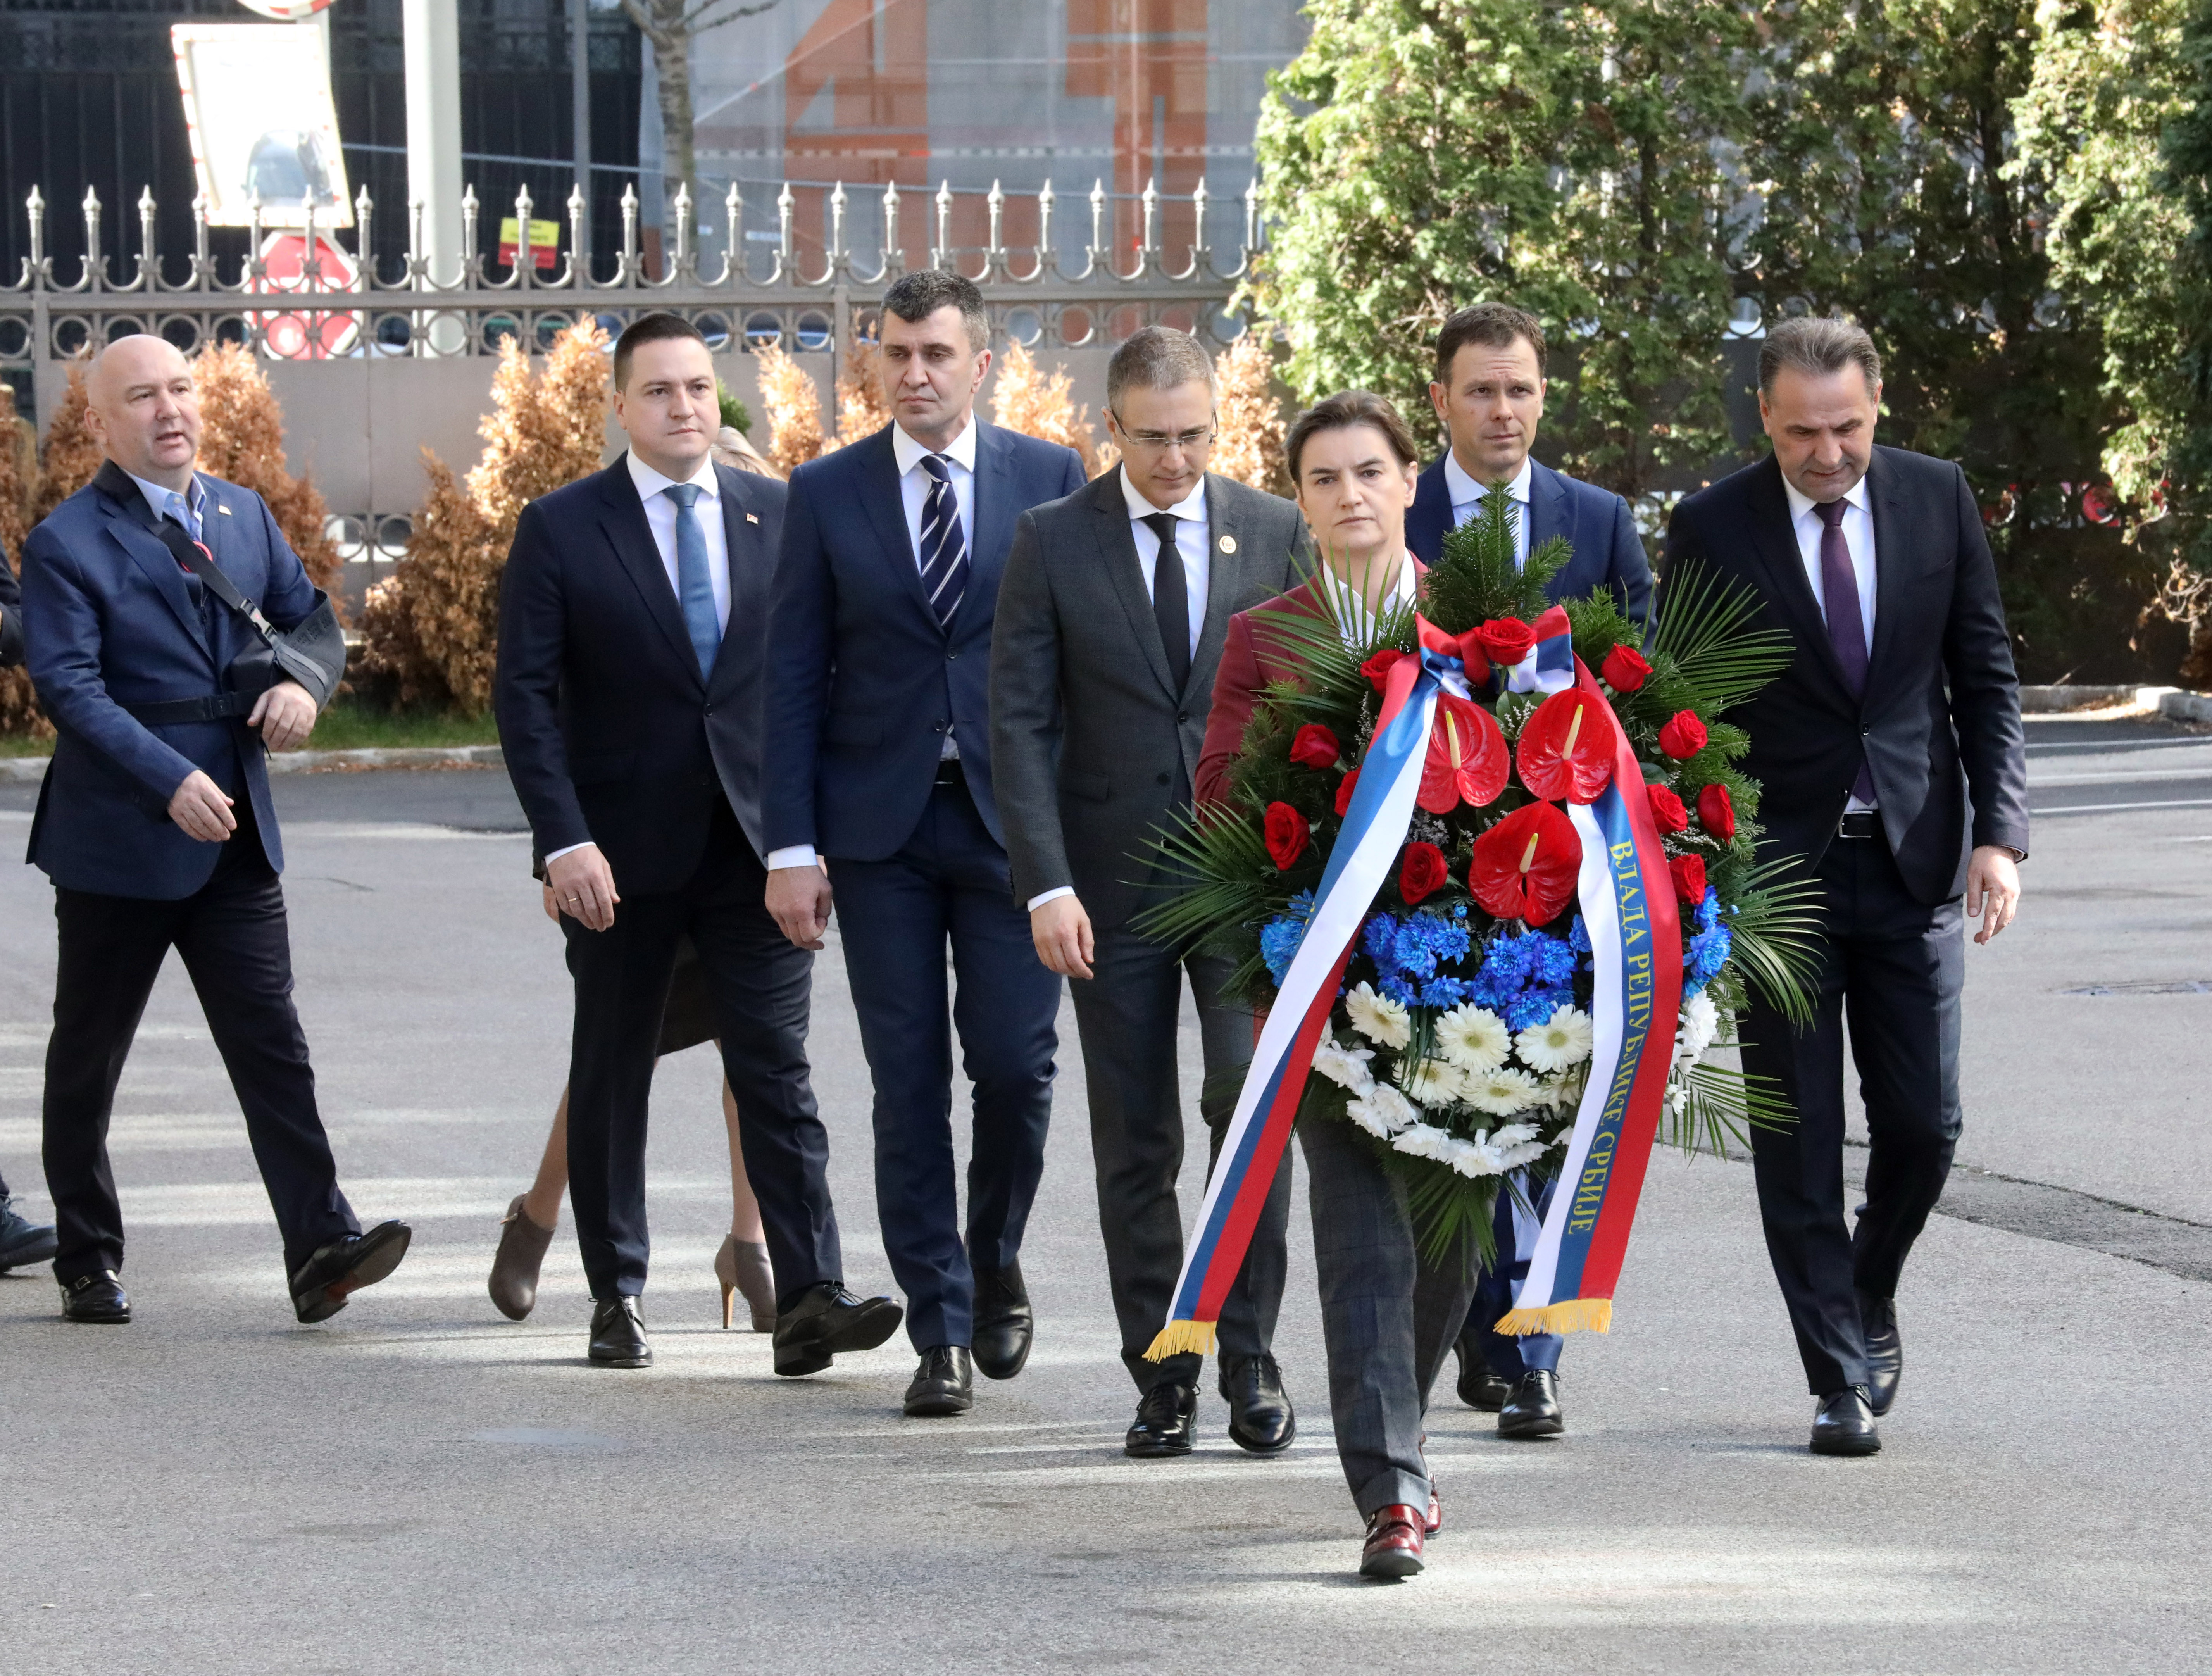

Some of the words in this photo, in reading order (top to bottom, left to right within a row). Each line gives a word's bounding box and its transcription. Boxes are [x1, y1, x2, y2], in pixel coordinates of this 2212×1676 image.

[1609, 838, 1647, 947] ВЛАДА
[1600, 950, 1651, 1126] РЕПУБЛИКЕ
[1568, 1131, 1615, 1235] СРБИЈЕ
